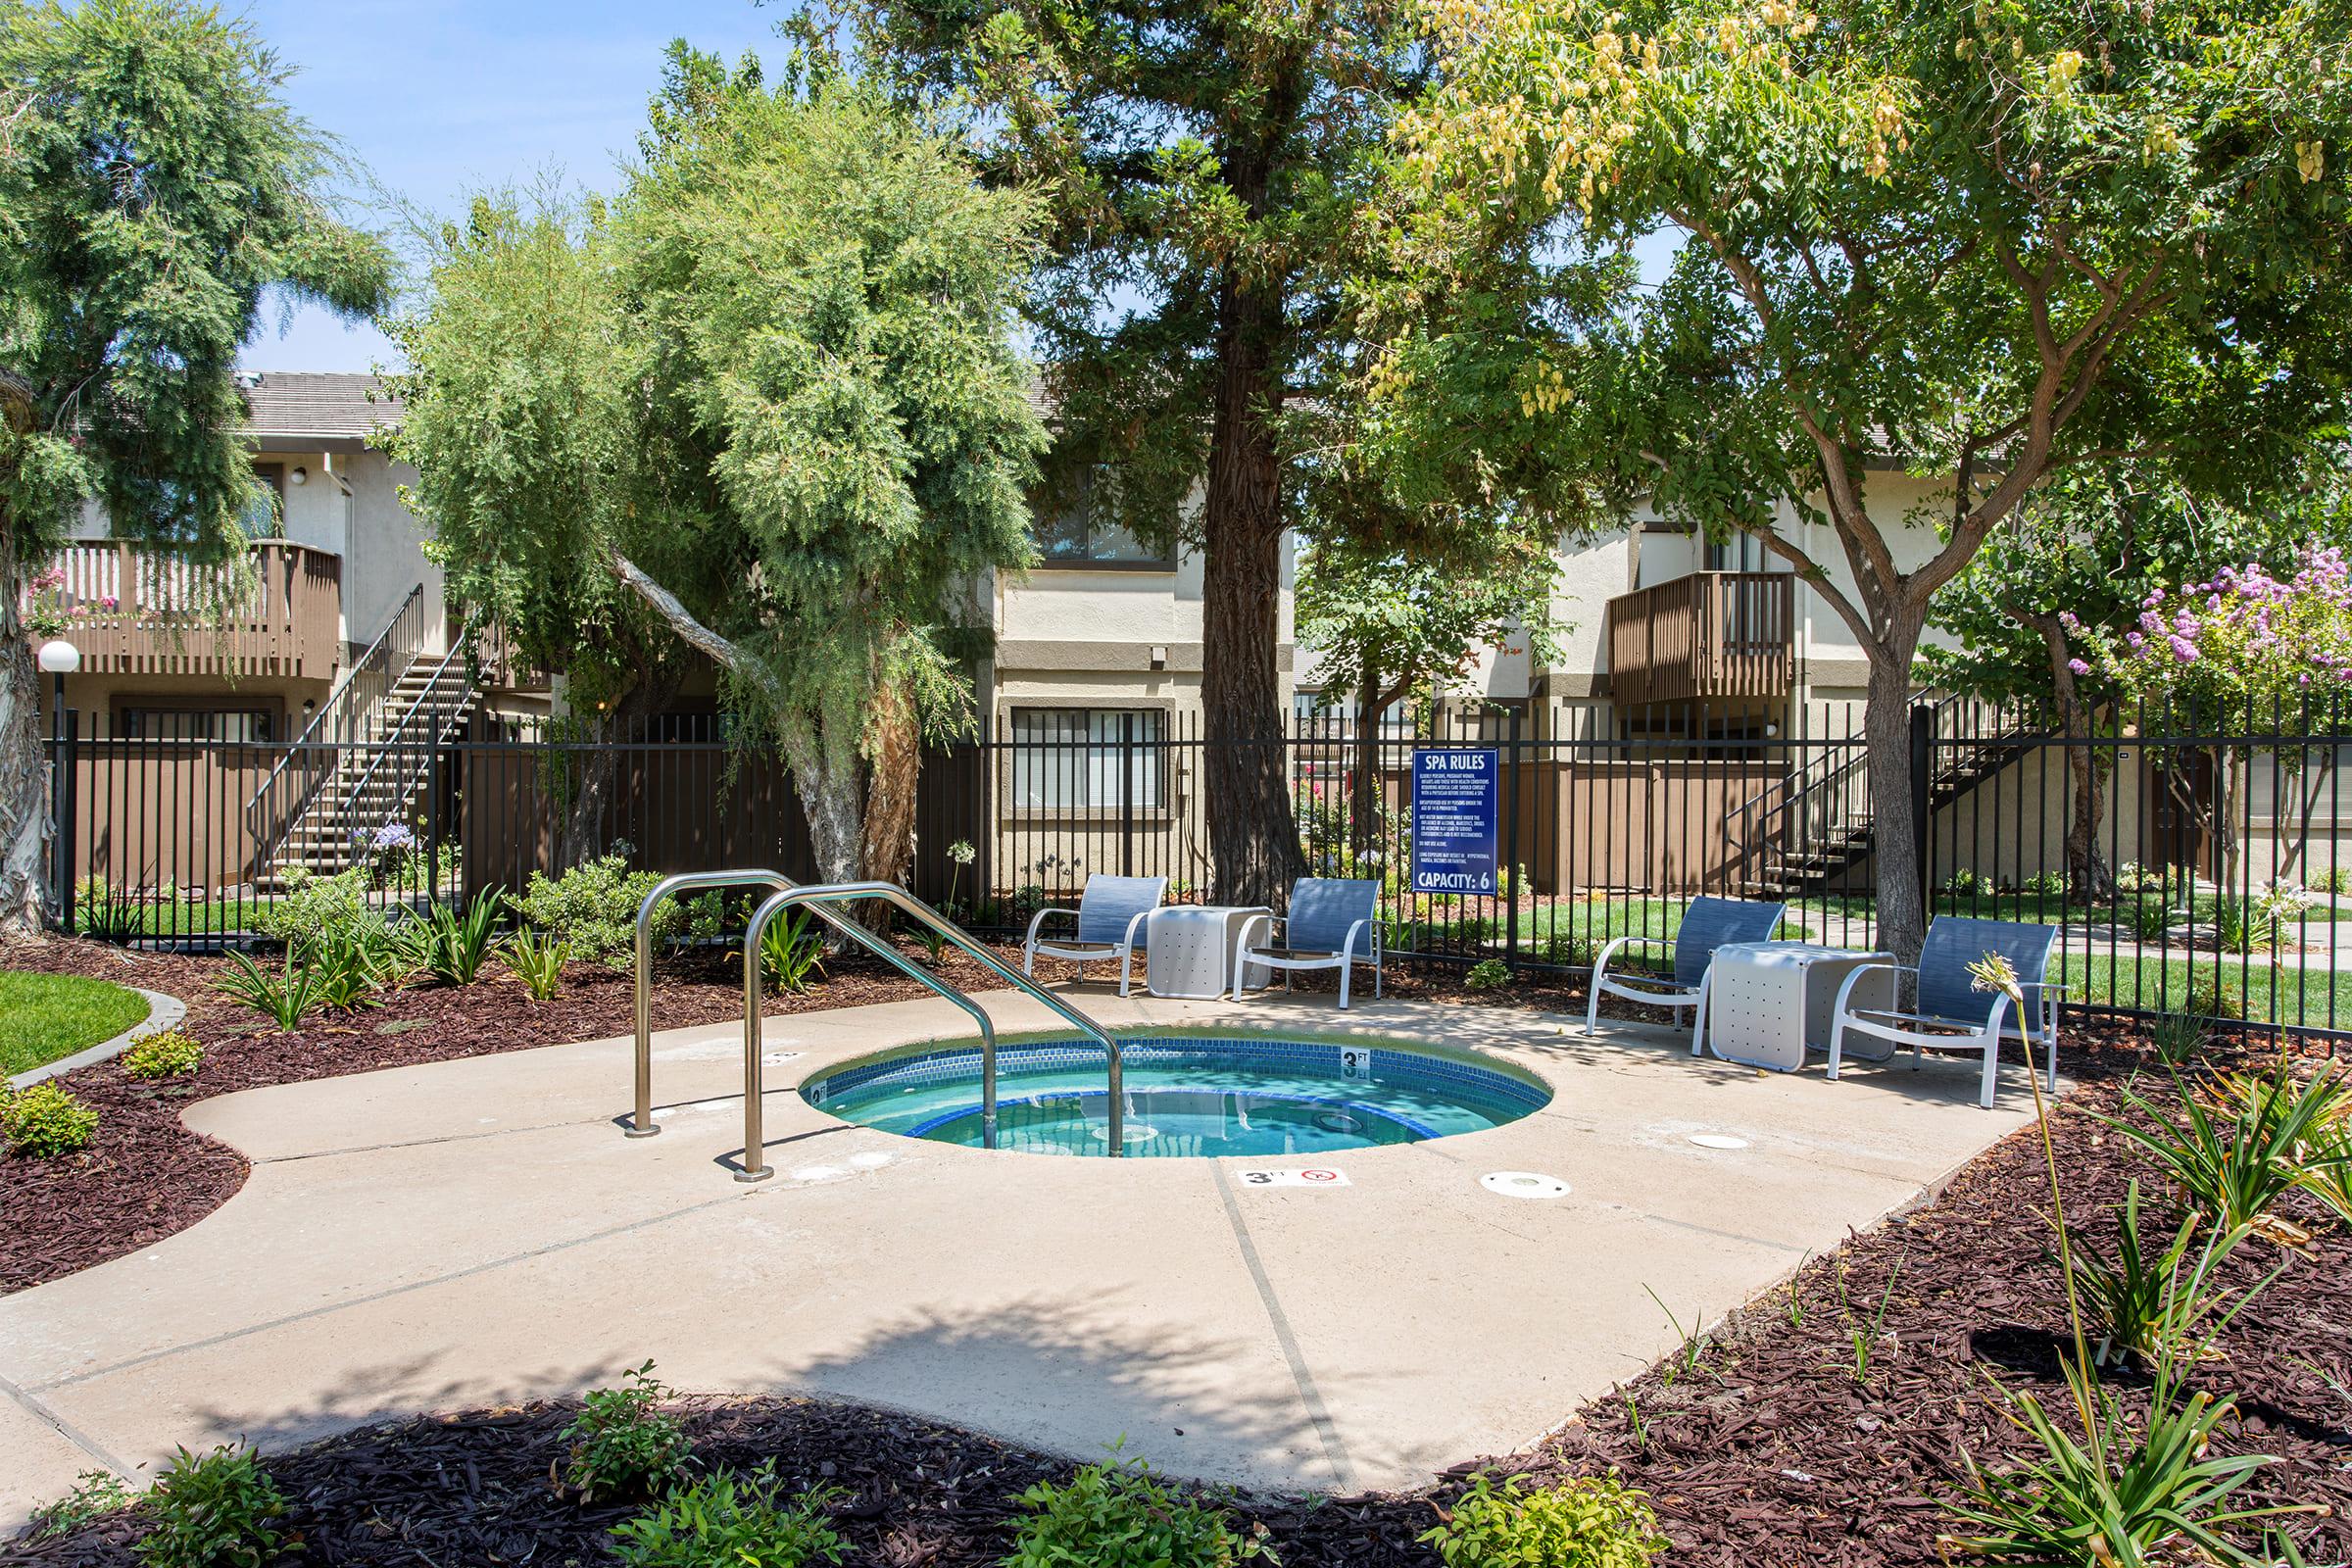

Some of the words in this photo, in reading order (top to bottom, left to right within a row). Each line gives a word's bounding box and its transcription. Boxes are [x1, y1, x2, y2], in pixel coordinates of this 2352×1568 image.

[1425, 755, 1446, 770] SPA
[1450, 755, 1485, 770] RULES
[1418, 872, 1476, 889] CAPACITY:
[1480, 872, 1490, 889] 6
[1358, 1053, 1368, 1061] FT
[1246, 1172, 1272, 1183] 3
